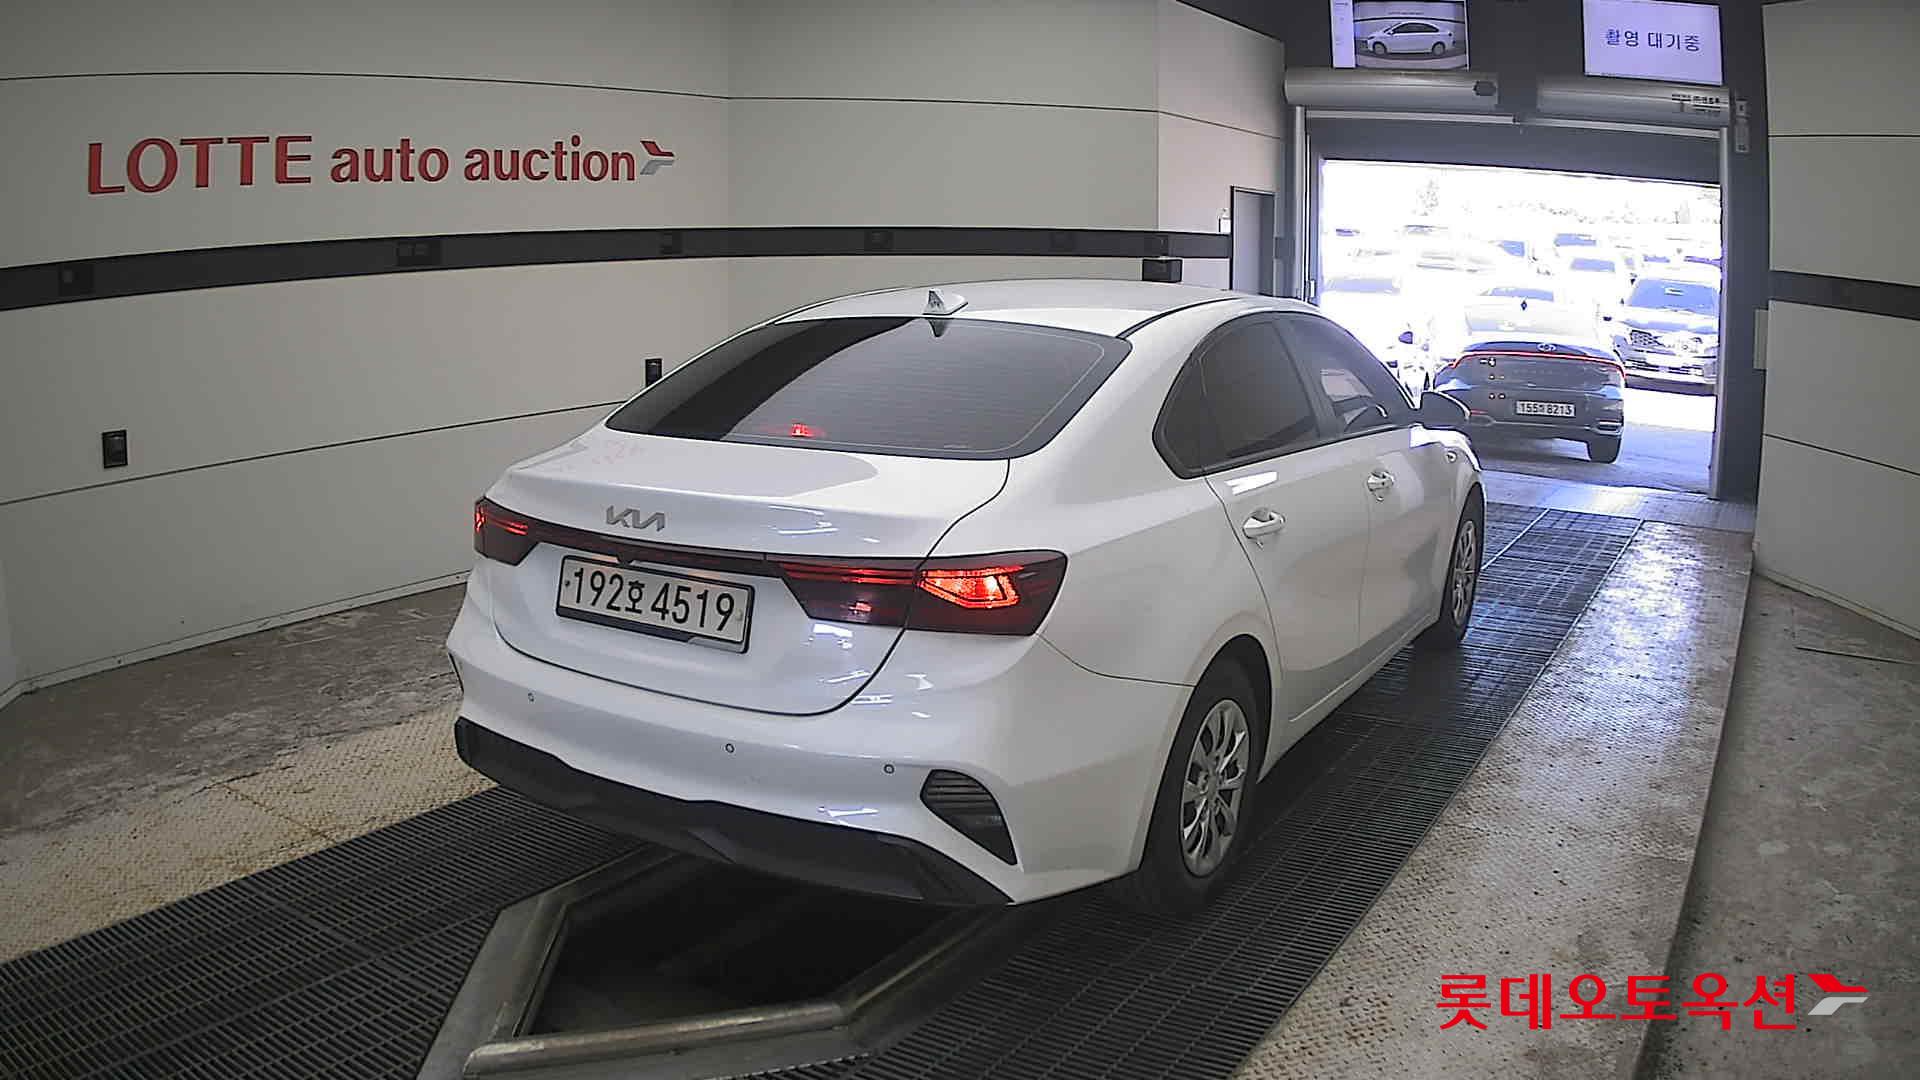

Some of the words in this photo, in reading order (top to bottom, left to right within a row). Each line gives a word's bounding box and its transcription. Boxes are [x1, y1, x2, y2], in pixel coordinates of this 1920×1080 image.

[1647, 31, 1701, 53] 대기중
[87, 135, 313, 195] LOTTE
[329, 137, 450, 183] auto
[463, 134, 636, 182] auction
[605, 504, 666, 532] KIA
